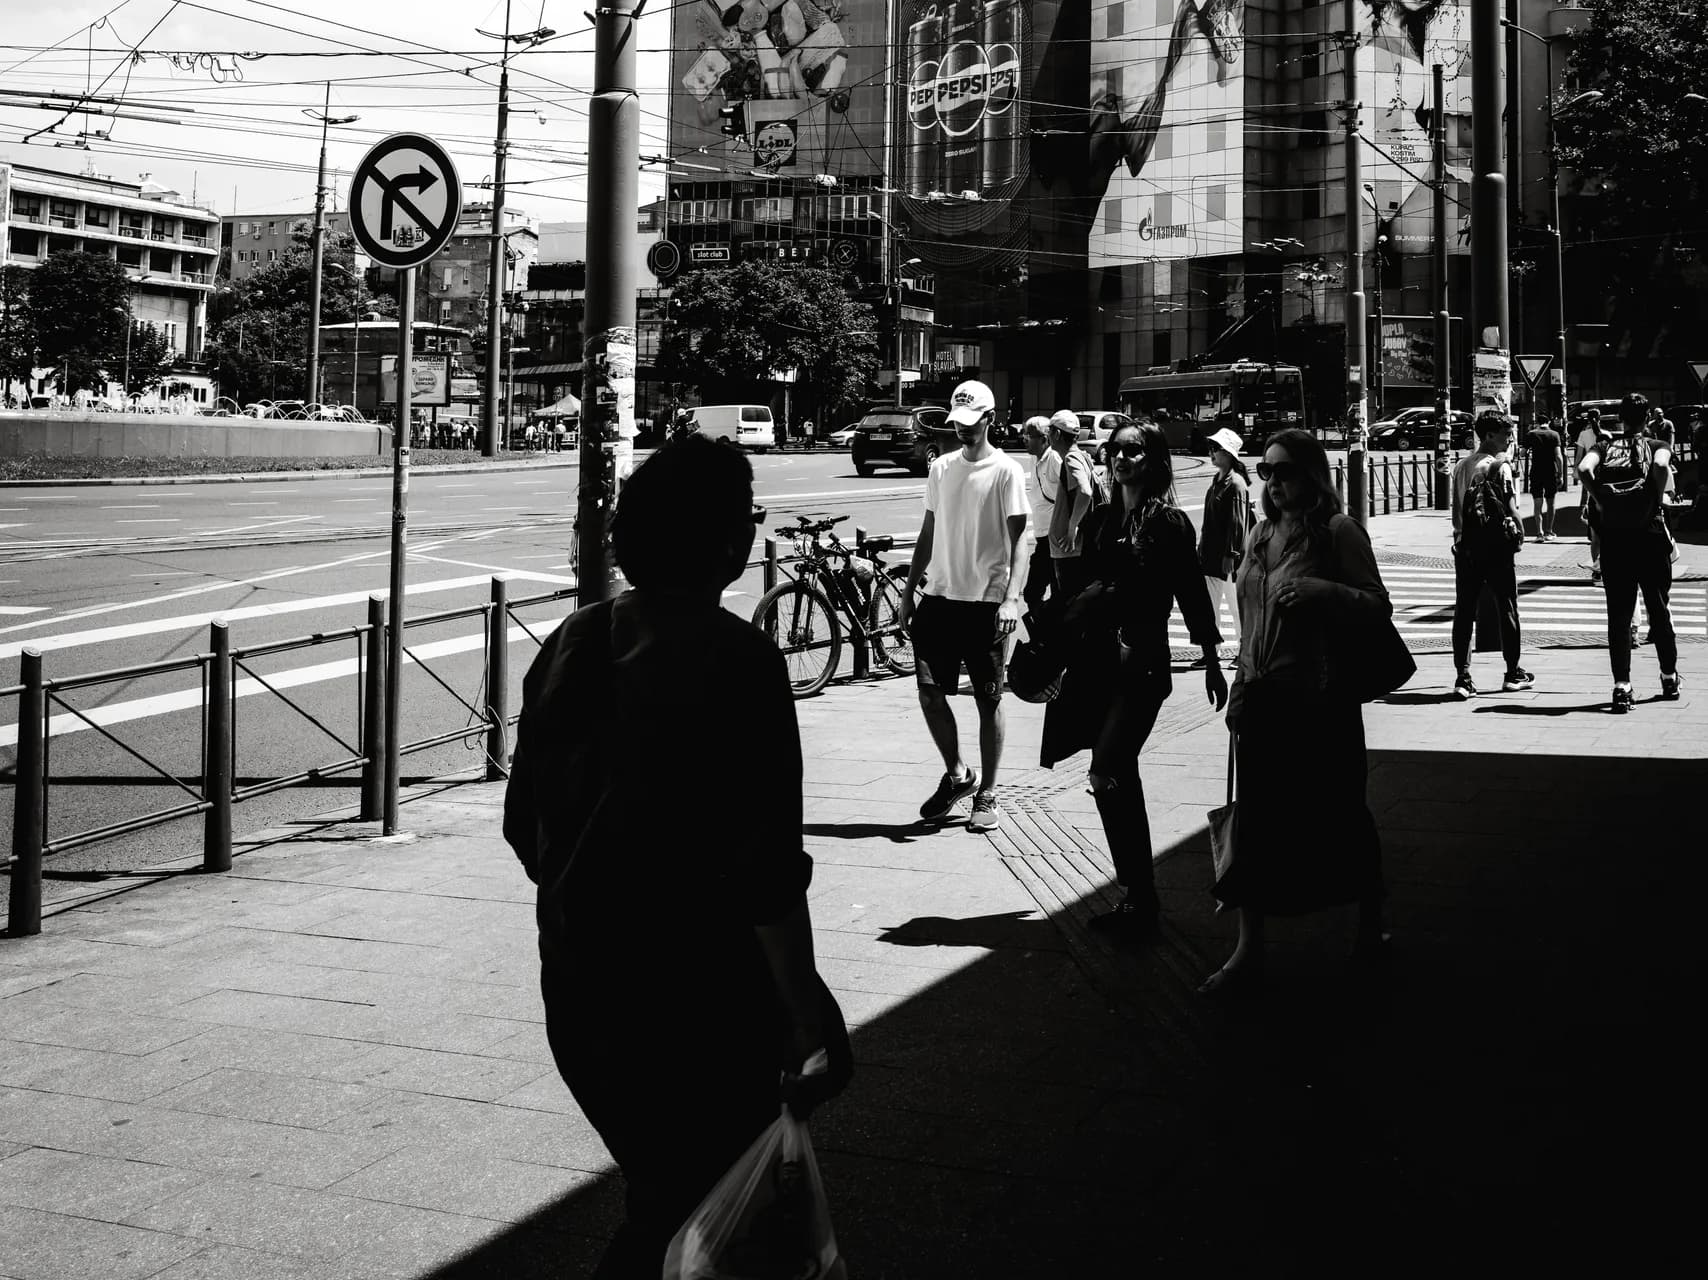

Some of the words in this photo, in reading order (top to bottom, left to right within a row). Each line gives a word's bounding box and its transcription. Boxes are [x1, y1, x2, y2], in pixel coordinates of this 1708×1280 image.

[937, 73, 987, 103] PEPSI
[910, 88, 933, 106] PEP
[935, 351, 953, 361] HOTEL
[933, 361, 956, 371] SLAVIJA
